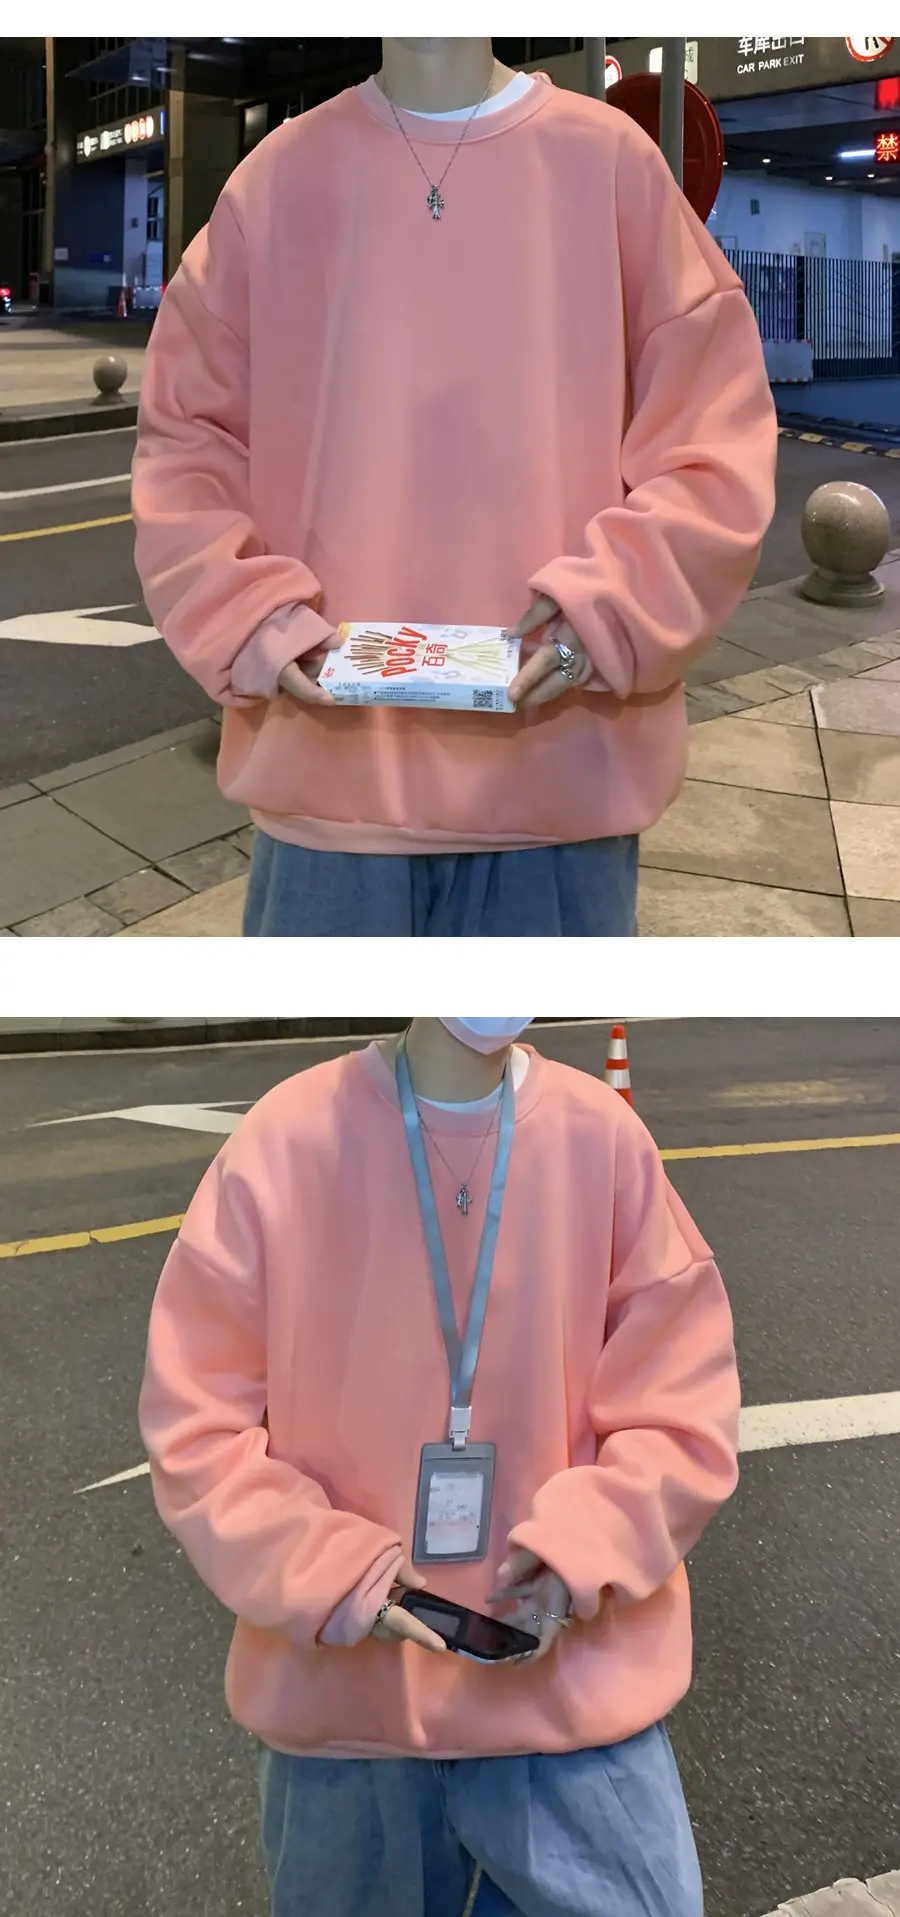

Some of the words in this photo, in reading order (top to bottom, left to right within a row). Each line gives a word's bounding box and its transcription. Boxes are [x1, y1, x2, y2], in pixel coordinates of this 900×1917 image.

[736, 62, 756, 74] CAR
[758, 58, 782, 71] PARK
[783, 54, 805, 67] EXIT
[876, 133, 899, 162] 禁
[421, 643, 448, 667] 百奇
